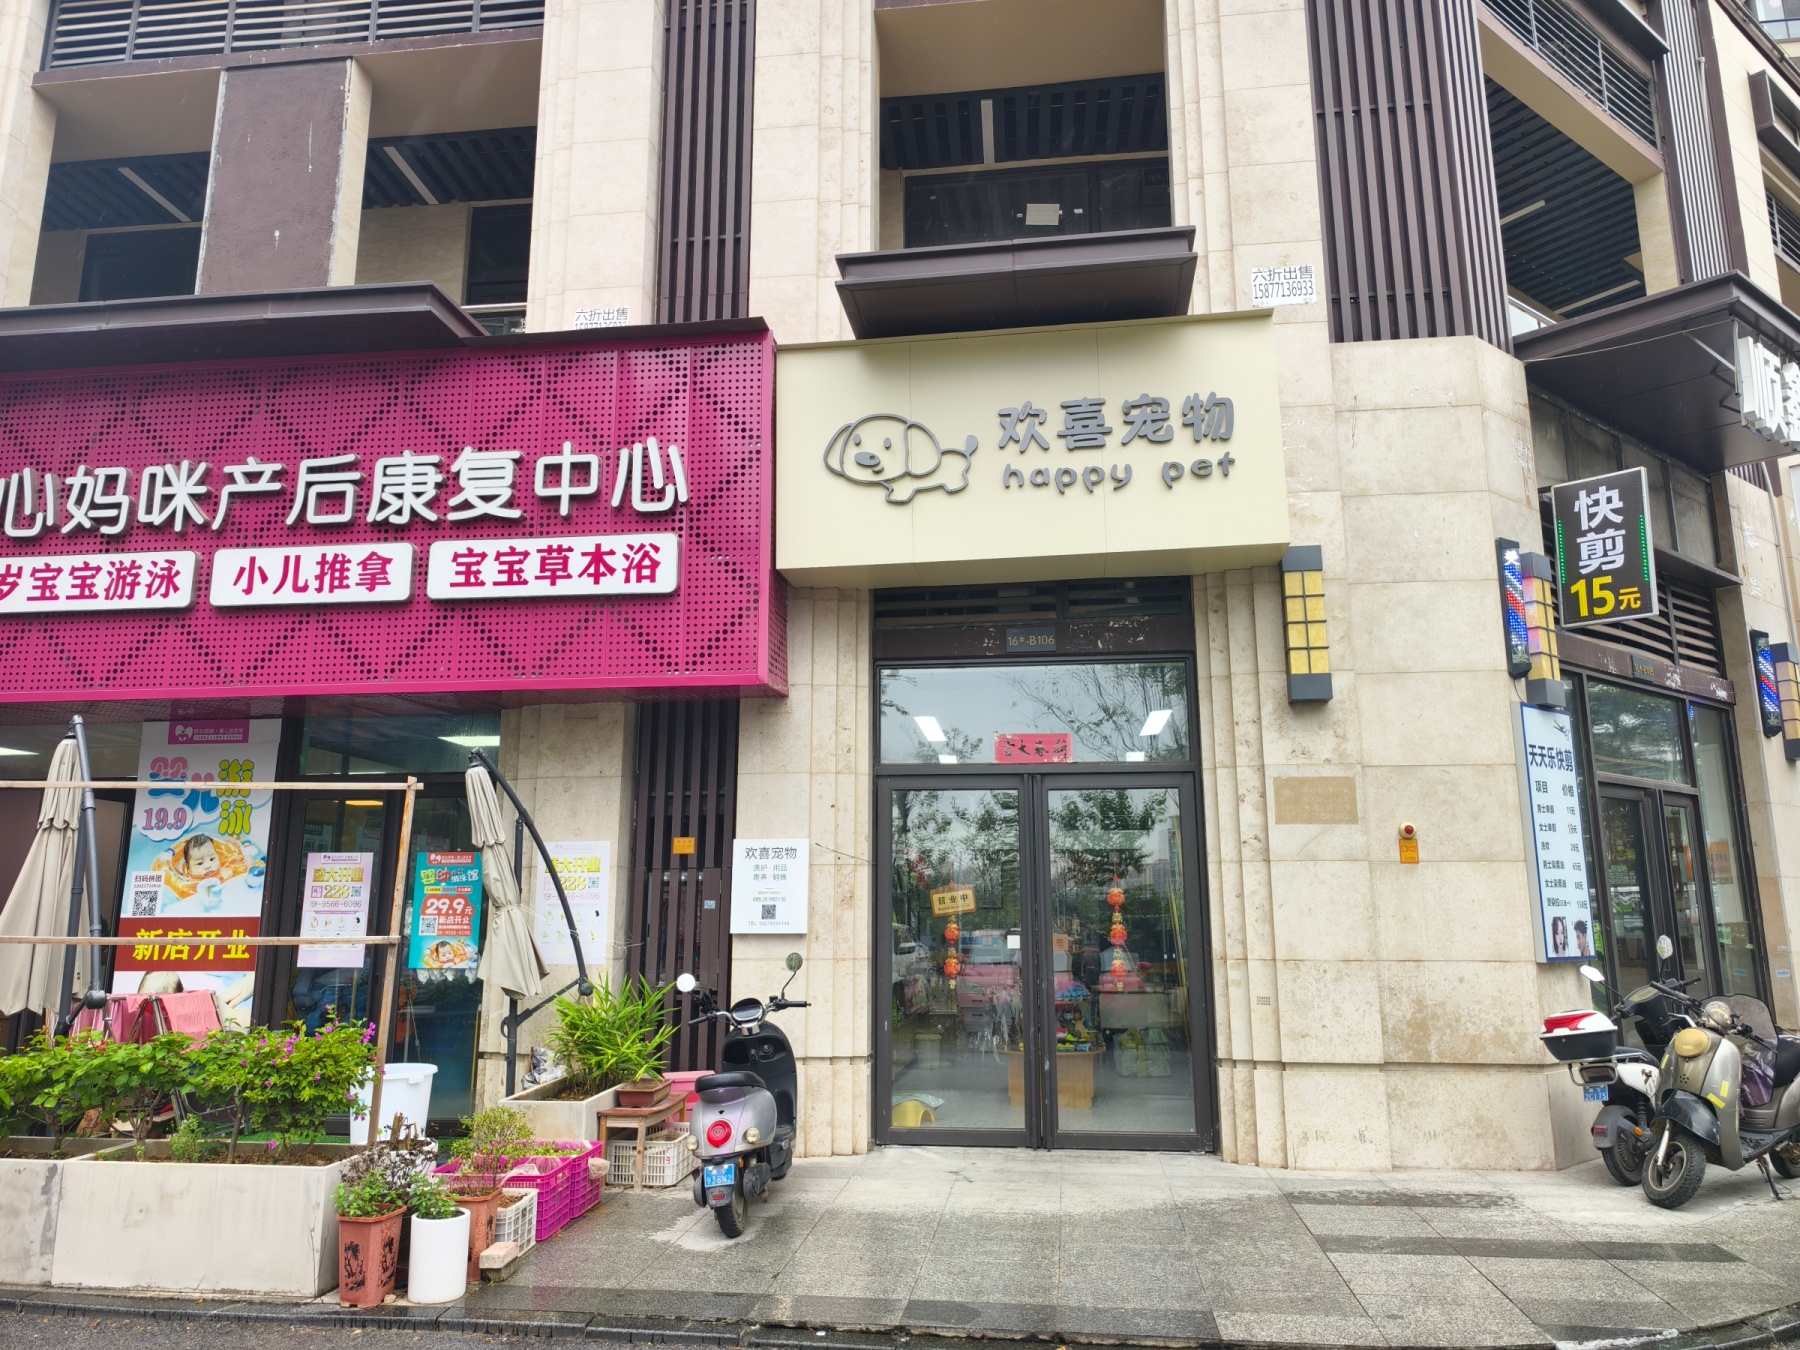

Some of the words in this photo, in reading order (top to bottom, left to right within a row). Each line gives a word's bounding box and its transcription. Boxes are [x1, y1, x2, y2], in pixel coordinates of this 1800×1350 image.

[1252, 265, 1313, 282] 六折出售
[1253, 280, 1314, 299] 15877136933
[575, 306, 628, 321] 六折出售
[998, 392, 1235, 453] 欢喜宠物
[0, 436, 689, 539] 心妈咪产后康复中心
[1002, 463, 1133, 494] happy
[1161, 452, 1236, 488] pet
[1574, 485, 1626, 575] 快剪
[233, 550, 394, 596] 小儿推拿
[449, 543, 661, 589] 宝宝草本浴
[1570, 575, 1641, 618] 15元
[1007, 635, 1055, 647] 16#-B106
[1528, 744, 1573, 772] 天天乐快剪
[147, 757, 219, 813] 婴儿
[216, 759, 254, 835] 游泳
[1535, 780, 1548, 794] 项目
[1562, 784, 1574, 797] 价格
[142, 807, 187, 830] 19.9
[745, 846, 797, 860] 欢喜宠物
[938, 893, 968, 905] 营业中
[133, 928, 249, 960] 新店开业
